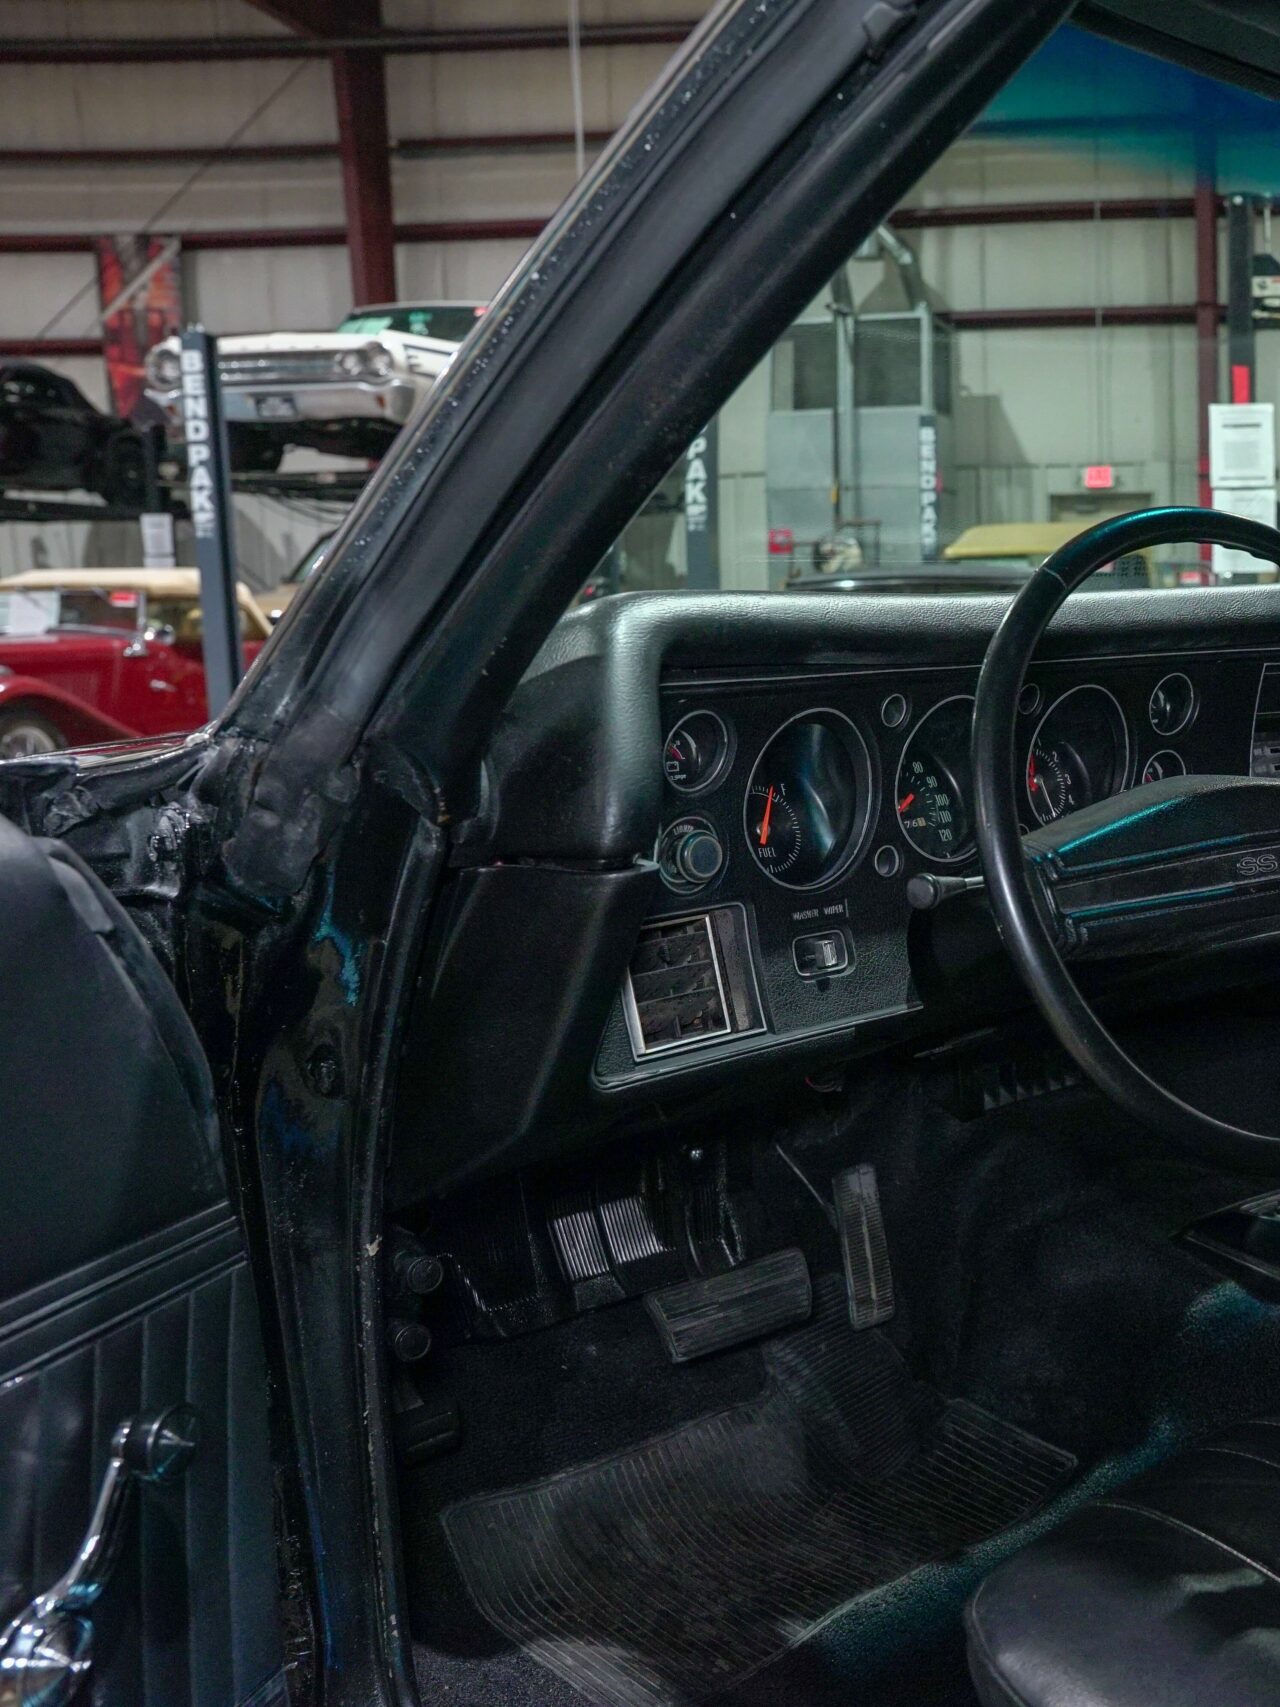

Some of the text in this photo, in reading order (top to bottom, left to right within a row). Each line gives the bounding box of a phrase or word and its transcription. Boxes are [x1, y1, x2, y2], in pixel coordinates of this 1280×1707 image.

[180, 350, 215, 513] BENDPAK
[912, 761, 924, 774] 80
[926, 775, 938, 789] 90
[935, 793, 950, 807] 100
[938, 828, 953, 842] 120
[758, 847, 777, 858] FUEL
[1238, 854, 1278, 876] SS
